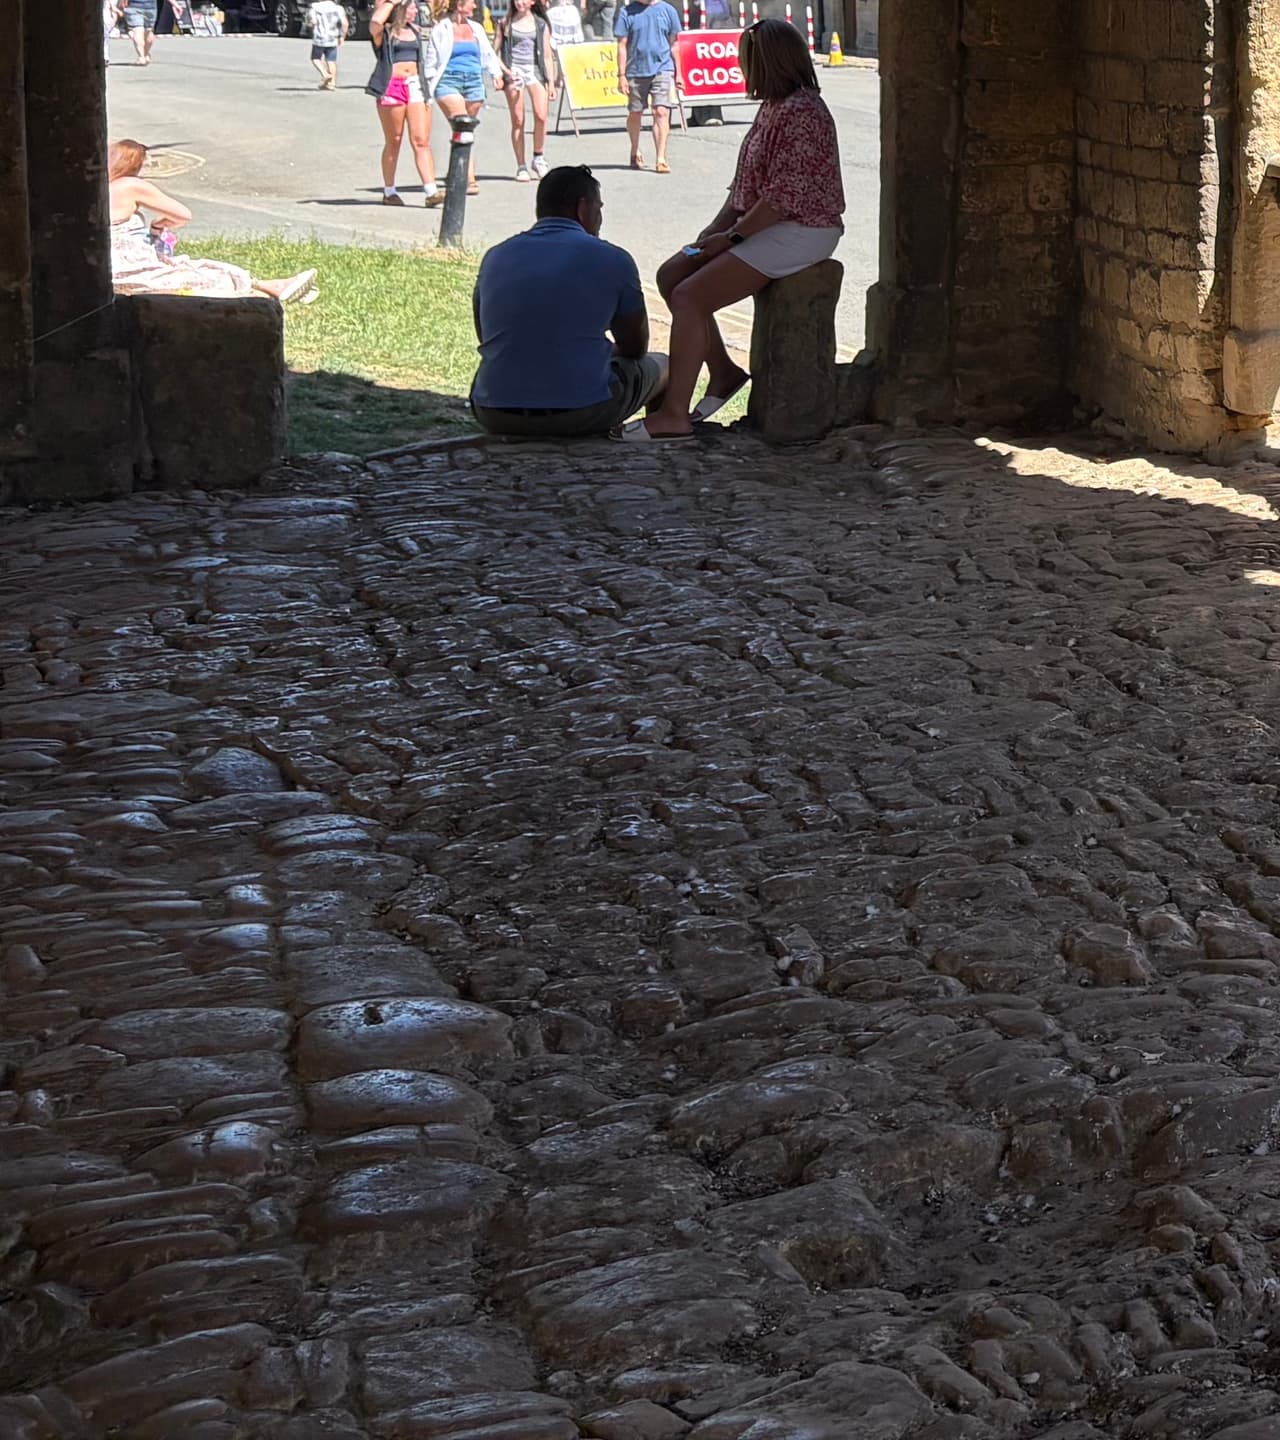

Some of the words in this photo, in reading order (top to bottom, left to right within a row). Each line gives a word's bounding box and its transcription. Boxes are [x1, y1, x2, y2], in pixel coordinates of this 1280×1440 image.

[599, 50, 614, 62] N
[695, 41, 740, 60] ROA
[584, 67, 619, 80] thro
[688, 66, 744, 87] CLOS
[602, 86, 619, 97] ro
